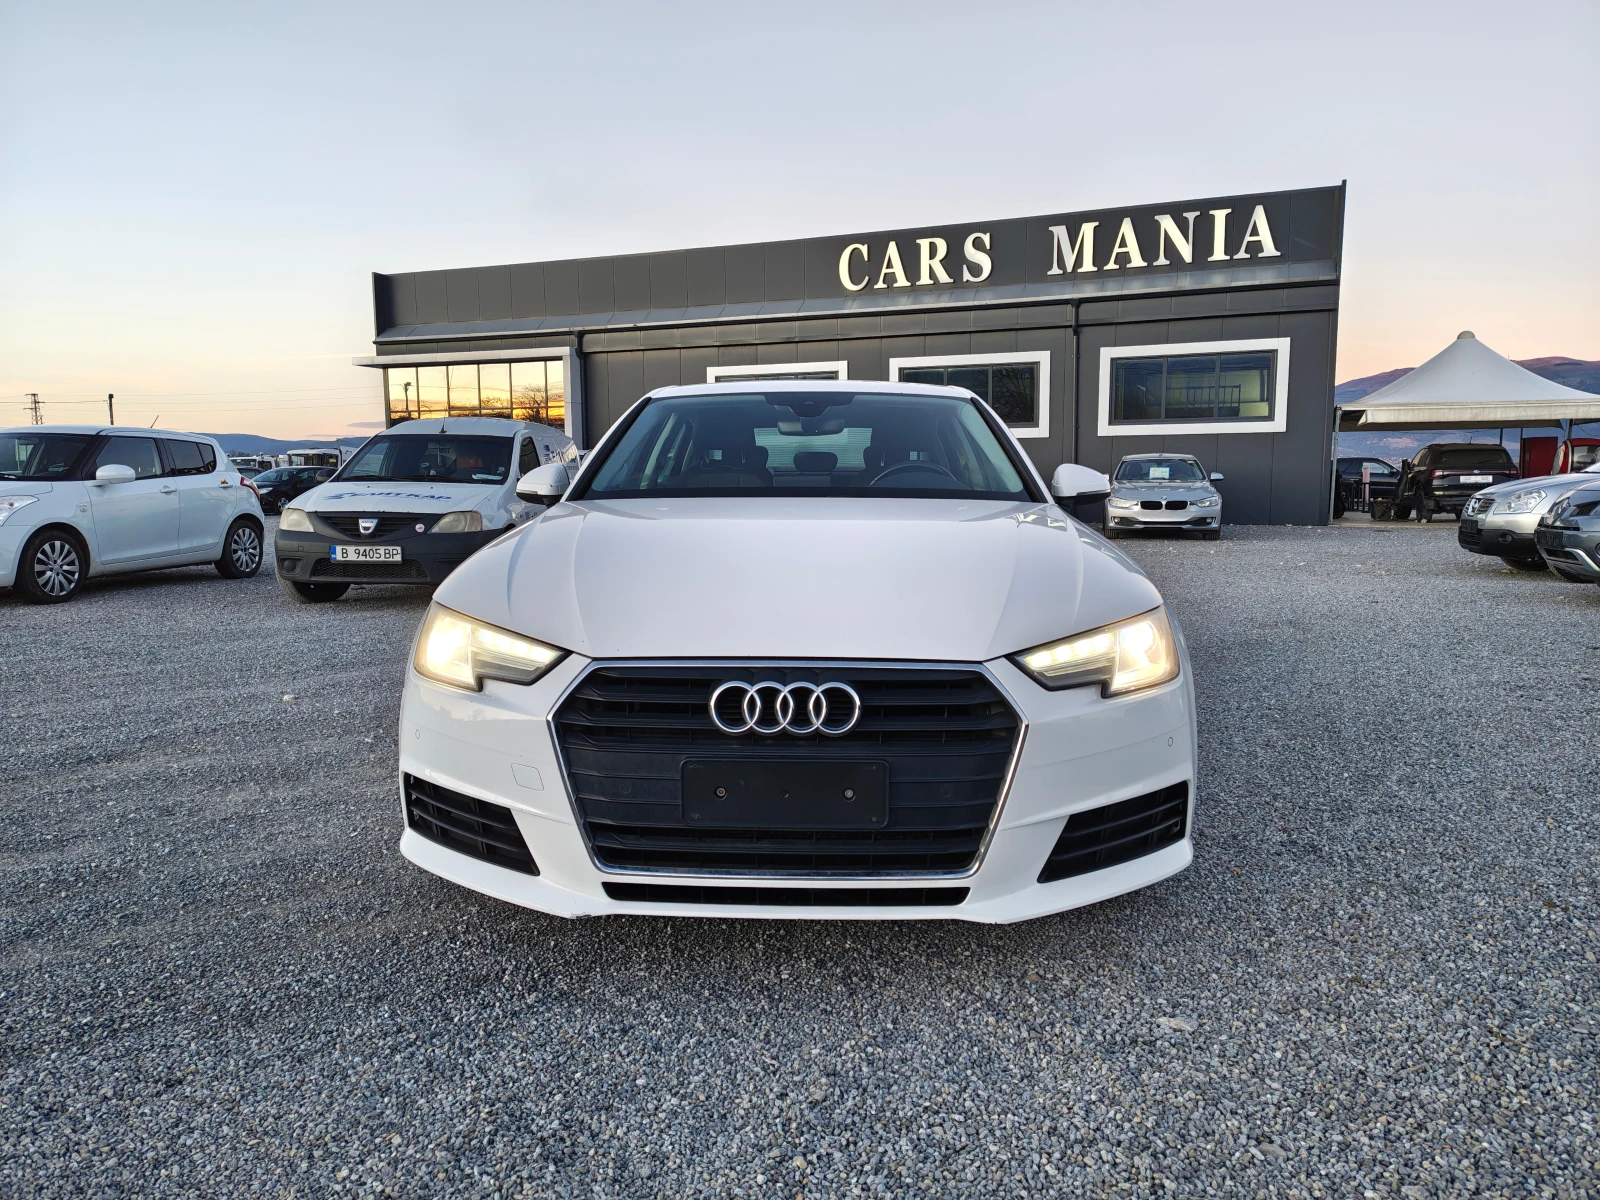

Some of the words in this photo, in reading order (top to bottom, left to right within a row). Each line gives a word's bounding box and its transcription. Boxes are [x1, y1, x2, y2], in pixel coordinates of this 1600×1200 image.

[838, 232, 993, 291] CARS
[1046, 204, 1281, 276] MANIA
[341, 547, 349, 559] B
[353, 548, 382, 560] 9405
[383, 548, 400, 560] BP
